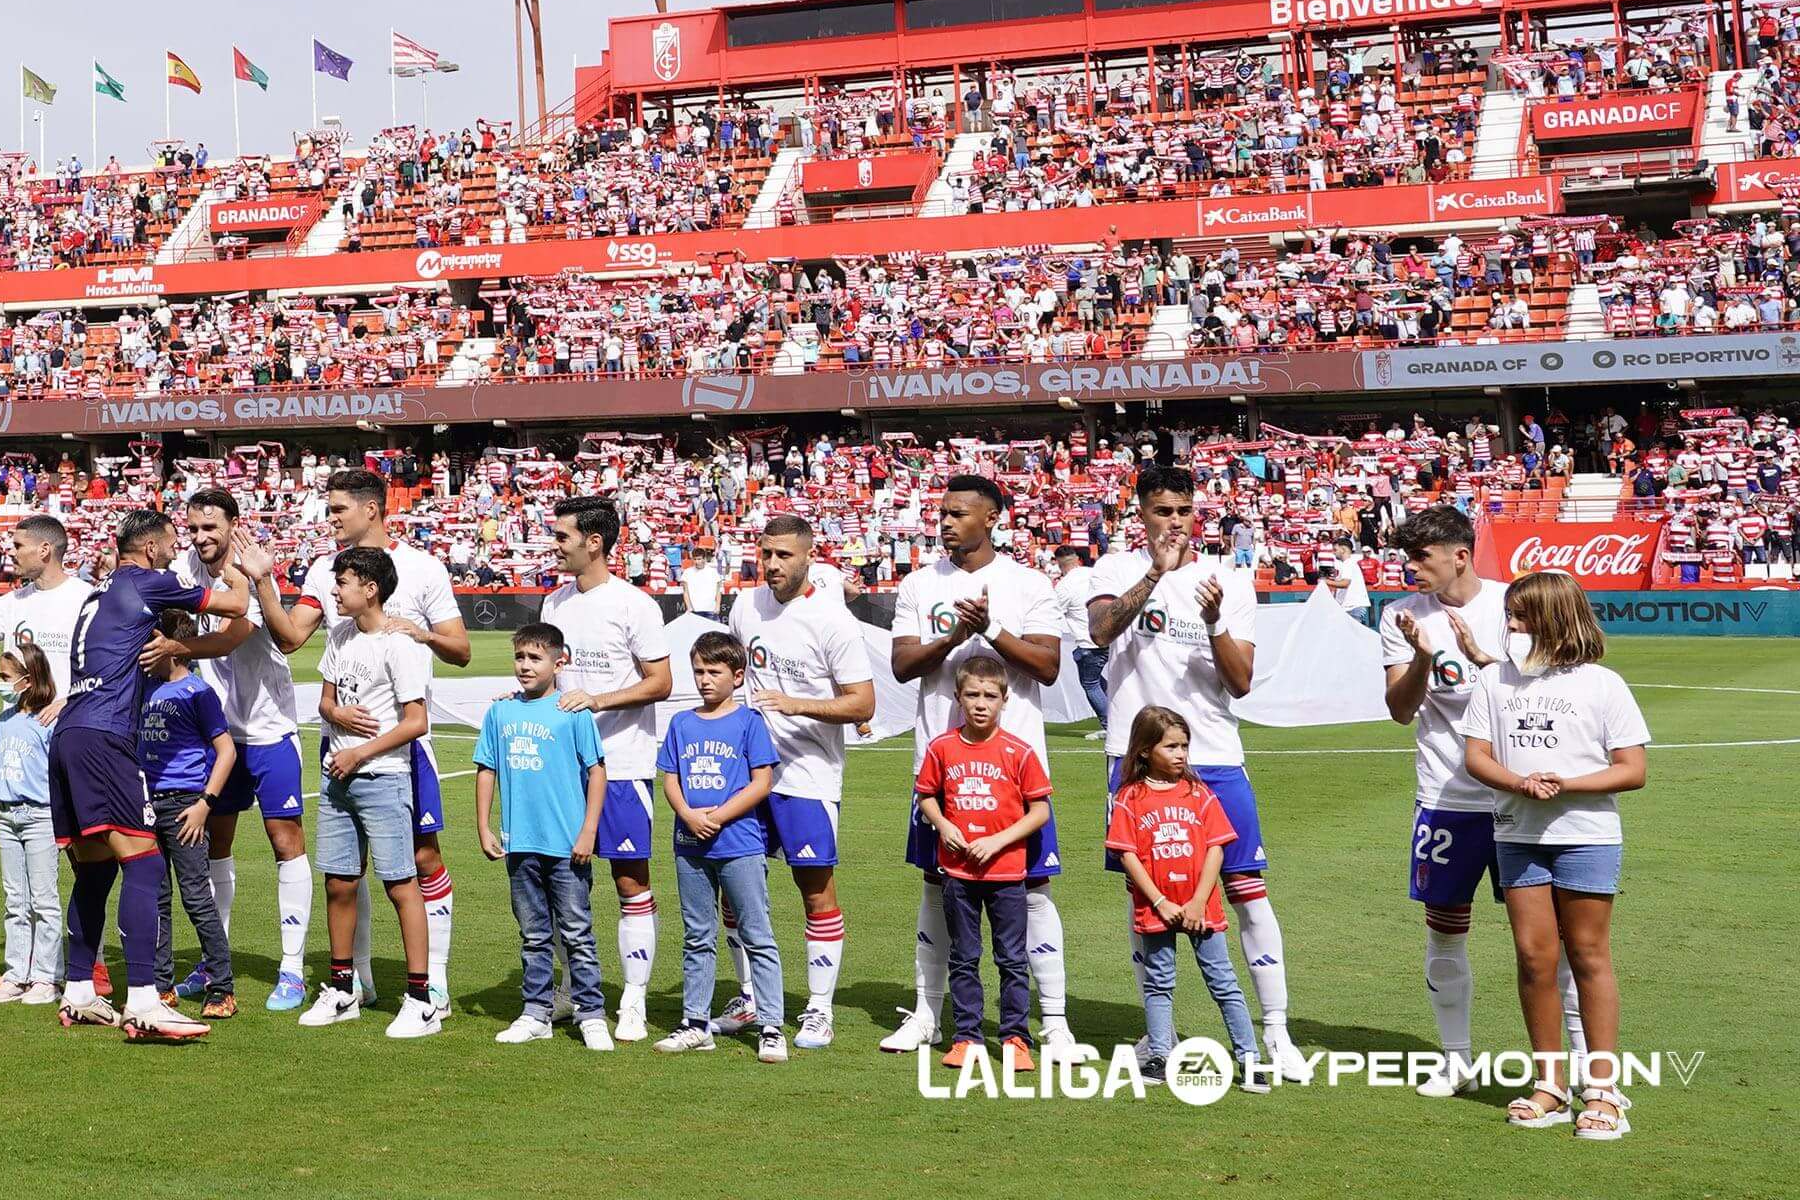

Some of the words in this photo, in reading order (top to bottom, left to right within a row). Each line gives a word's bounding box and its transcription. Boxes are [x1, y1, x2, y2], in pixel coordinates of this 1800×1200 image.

[1458, 189, 1546, 208] CaixaBank
[1225, 206, 1306, 224] CaixaBank
[441, 253, 503, 265] micamotor
[1407, 359, 1498, 375] GRANADA
[1502, 358, 1528, 371] CF
[1623, 353, 1651, 366] RC
[1655, 349, 1771, 365] DEPORTIVO
[869, 370, 1031, 398] ¡VAMOS,
[1040, 360, 1262, 392] GRANADA!
[102, 399, 228, 424] ¡VAMOS,
[234, 393, 403, 420] GRANADA!
[1510, 533, 1650, 576] Coca-Cola
[1169, 618, 1205, 631] Fibros
[575, 649, 610, 659] Fibrosis
[1507, 697, 1531, 713] HOY
[1538, 696, 1572, 715] PUEDO
[522, 721, 550, 740] PUEDO
[704, 740, 733, 758] PUEDO
[1509, 734, 1559, 749] TODO
[949, 764, 966, 779] HOY
[971, 761, 1001, 780] PUEDO
[687, 774, 727, 790] TODO
[954, 795, 999, 811] TODO
[1143, 811, 1160, 829] HOY
[1166, 805, 1195, 824] PUEDO
[1161, 825, 1180, 838] CON
[1152, 841, 1193, 860] TODO
[1415, 823, 1453, 865] 22
